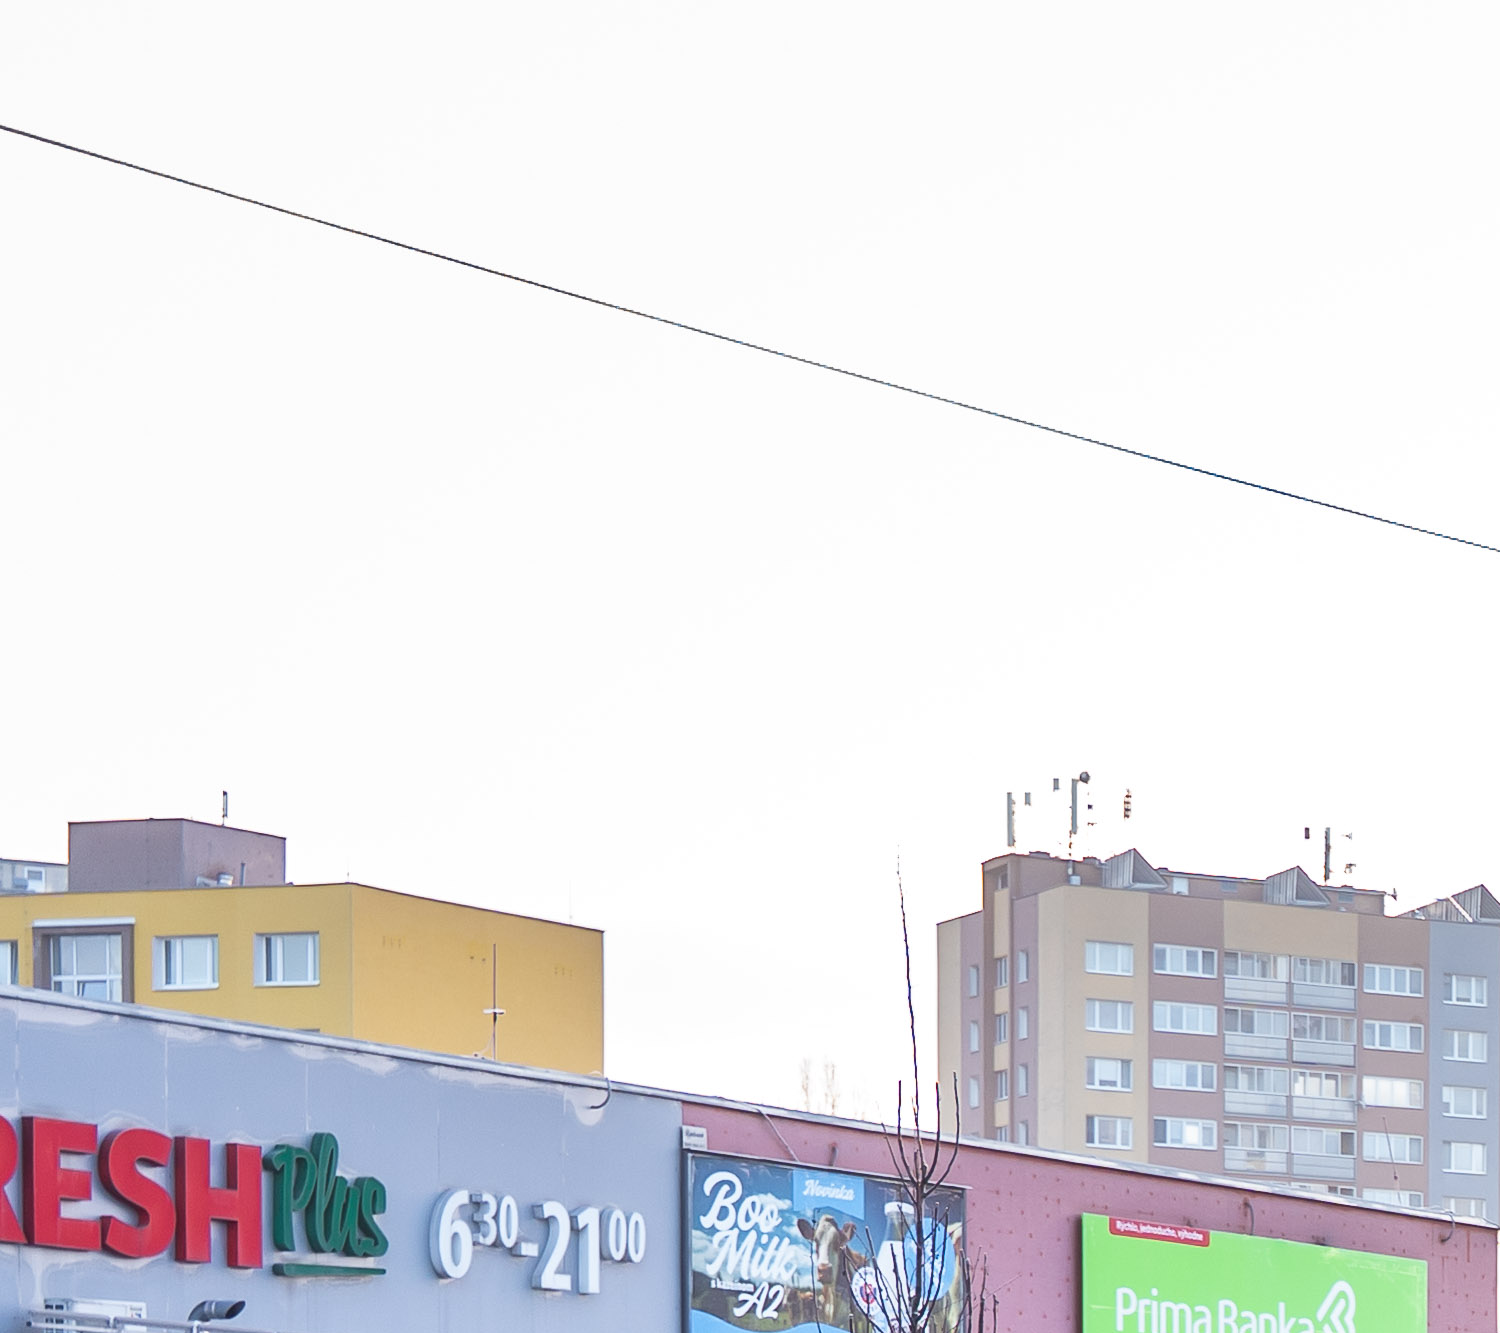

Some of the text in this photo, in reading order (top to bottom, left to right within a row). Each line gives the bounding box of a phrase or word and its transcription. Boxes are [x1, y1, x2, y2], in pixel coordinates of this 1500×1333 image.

[262, 1132, 389, 1257] Plus
[700, 1171, 782, 1233] Boo
[803, 1179, 856, 1201] Novinka
[706, 1227, 798, 1282] Milk
[733, 1281, 785, 1320] A2
